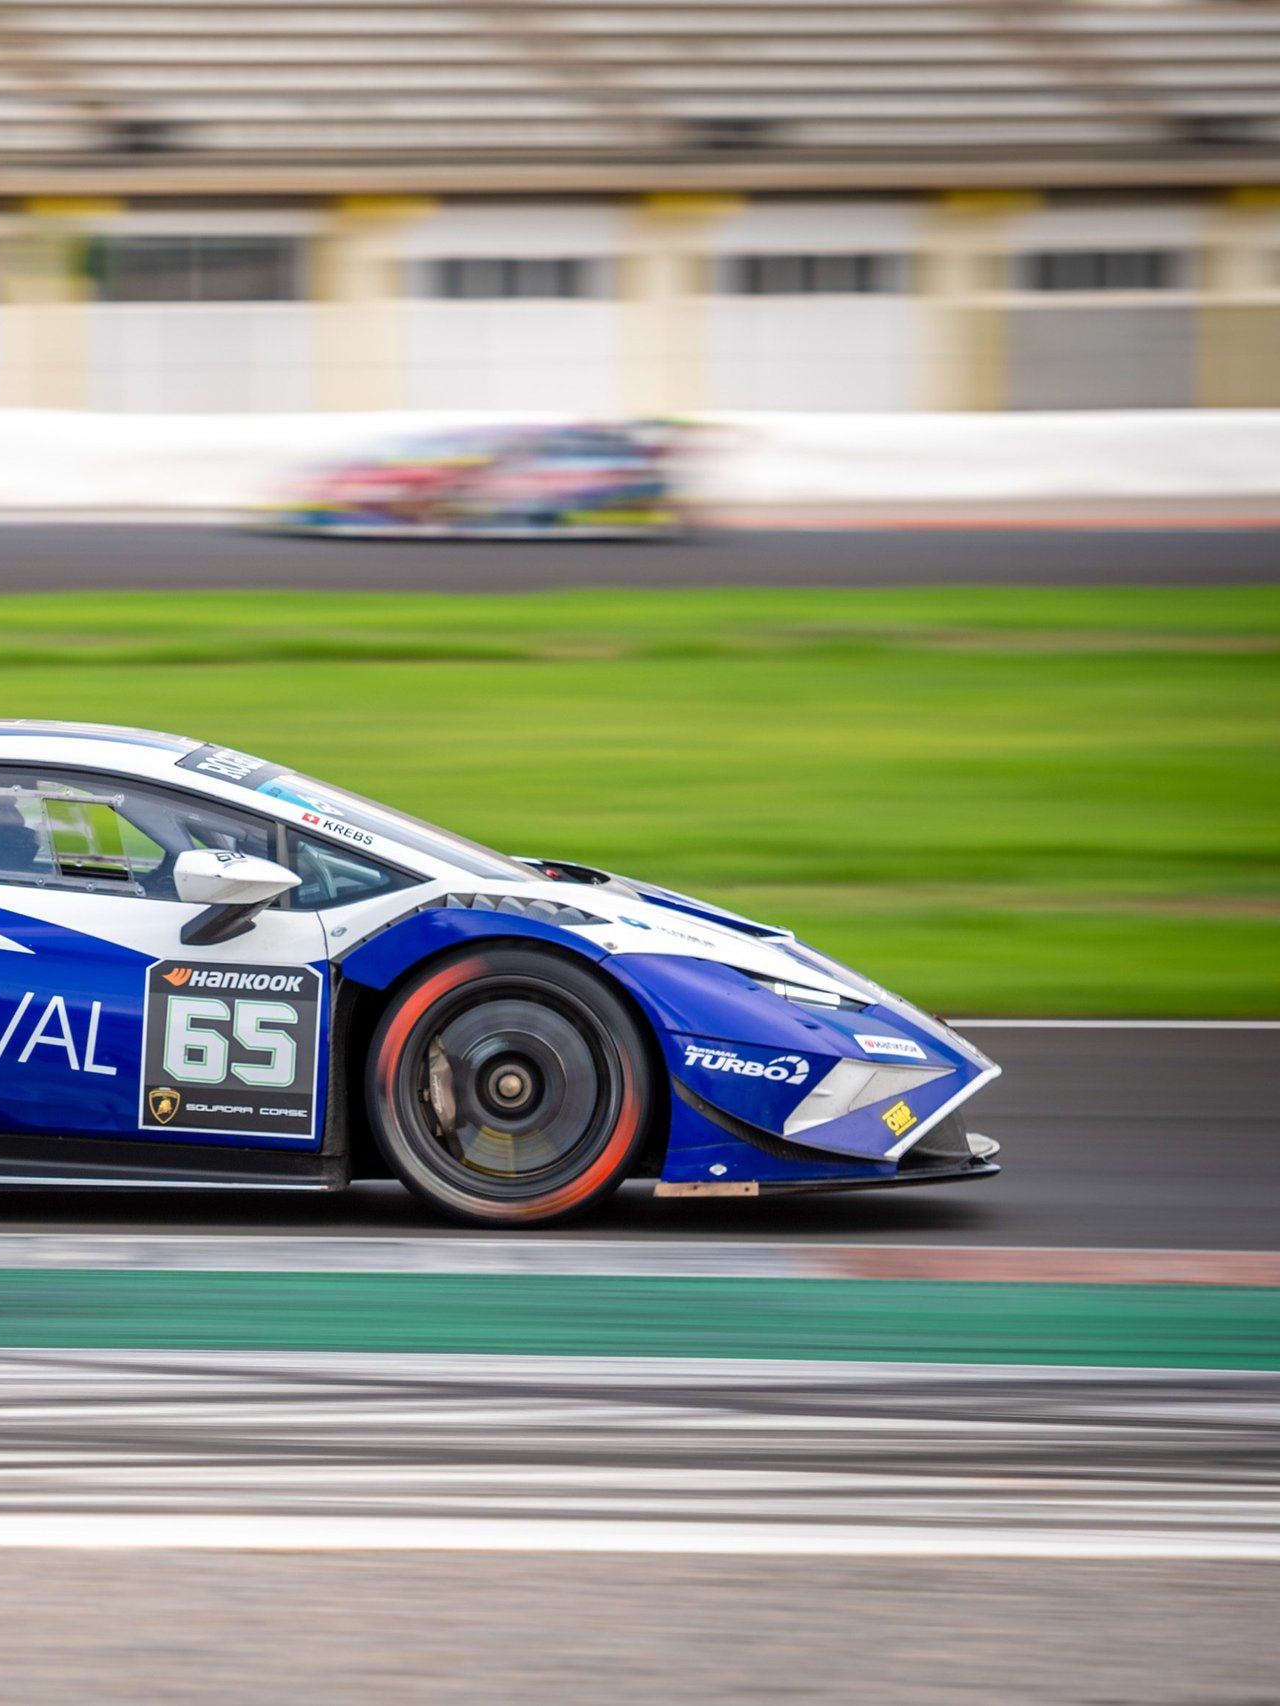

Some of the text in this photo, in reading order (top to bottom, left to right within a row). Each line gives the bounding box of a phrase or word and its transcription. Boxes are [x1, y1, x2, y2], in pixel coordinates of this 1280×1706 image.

[322, 819, 374, 845] KREBS
[163, 995, 299, 1087] 65
[684, 1052, 789, 1081] TURBO
[185, 1103, 308, 1118] SQUADRA CORSE
[886, 1104, 911, 1131] OMP
